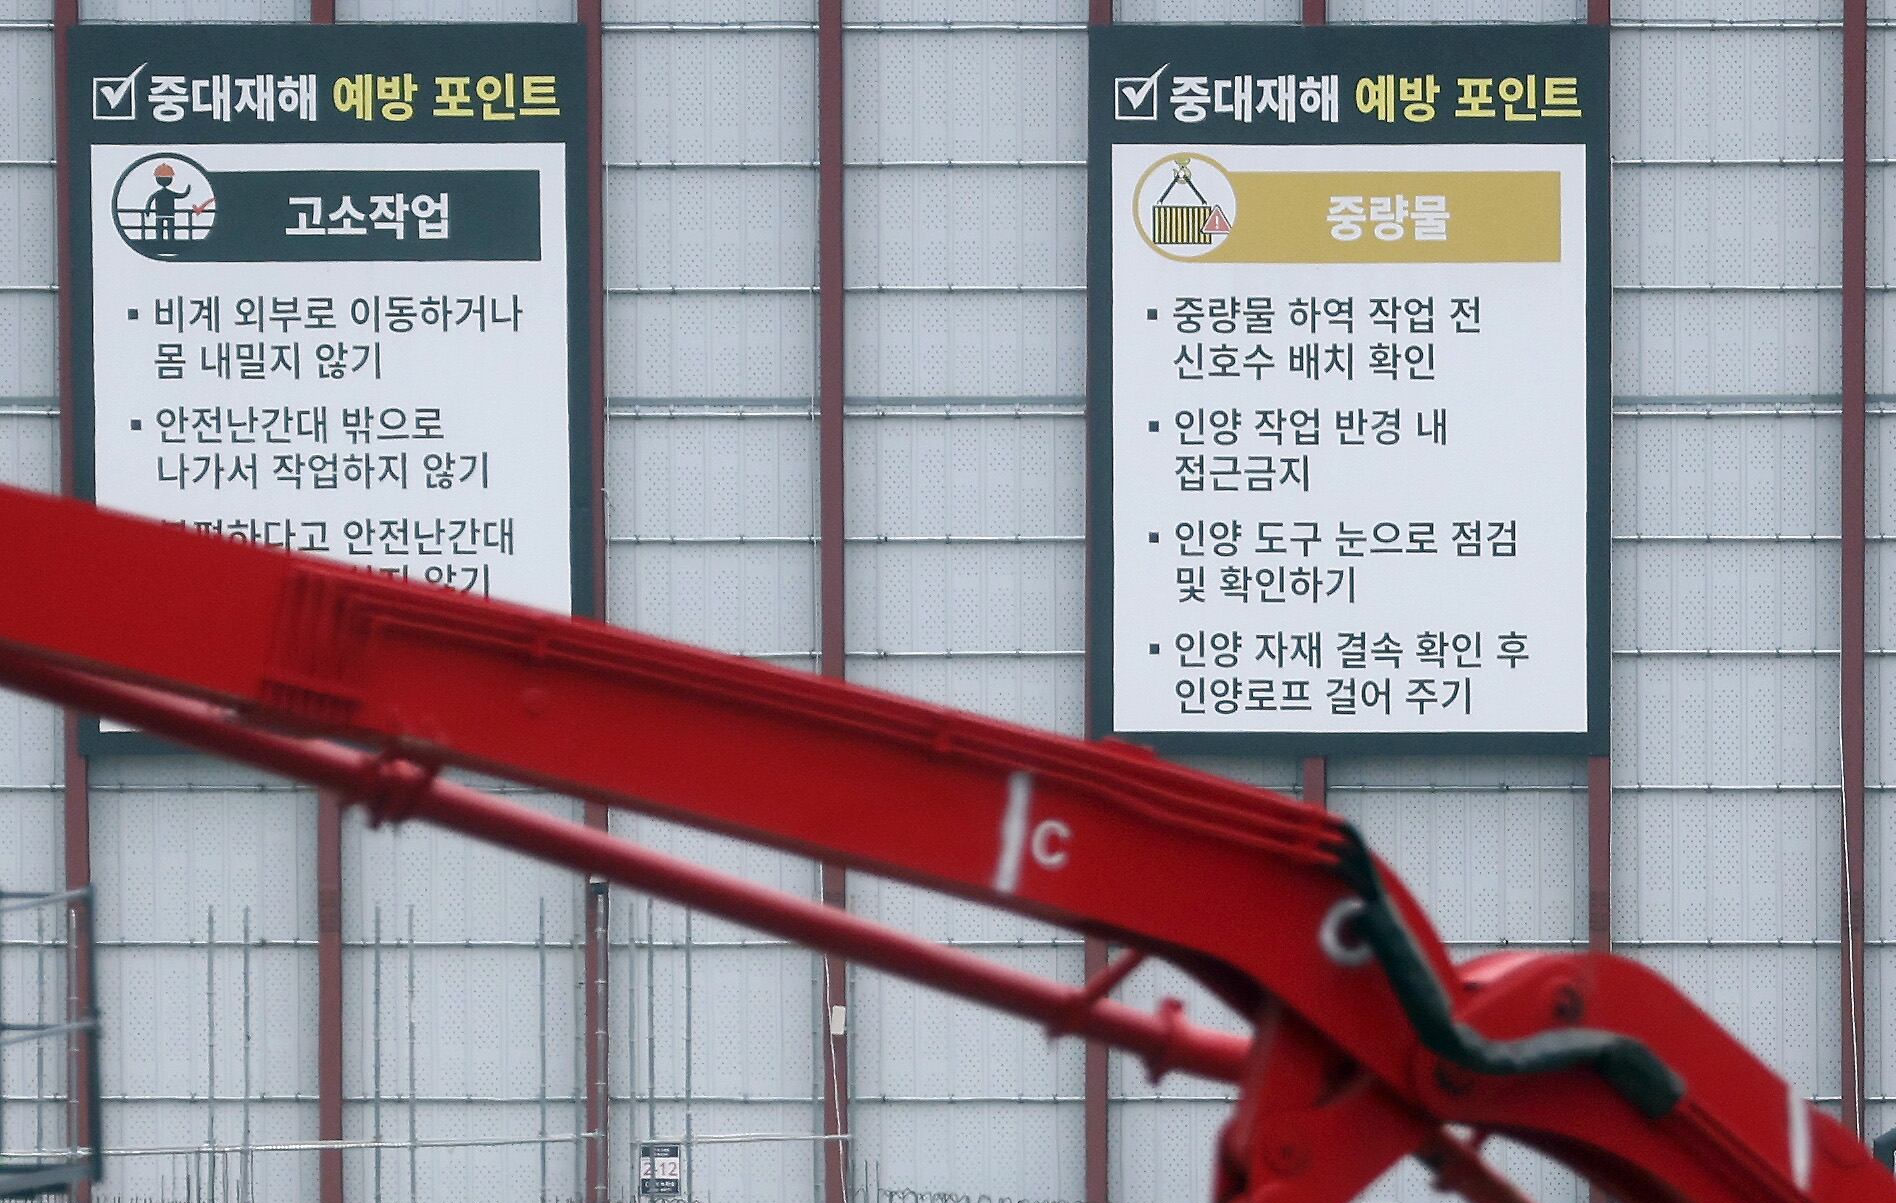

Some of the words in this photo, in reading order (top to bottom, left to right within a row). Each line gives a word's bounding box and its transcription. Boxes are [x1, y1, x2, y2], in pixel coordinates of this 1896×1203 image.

[148, 74, 316, 122] 중대재해
[334, 73, 418, 121] 예방
[433, 73, 560, 120] 포인트
[1170, 75, 1338, 123] 중대재해
[1356, 74, 1440, 122] 예방
[1455, 75, 1581, 121] 포인트
[286, 193, 448, 239] 고소작업
[1327, 194, 1450, 241] 중량물
[156, 296, 219, 333] 비계
[235, 296, 336, 333] 외부로
[351, 295, 523, 332] 이동하거나
[1173, 297, 1275, 334] 중량물
[1289, 297, 1353, 333] 하역
[1370, 297, 1433, 333] 작업
[1451, 297, 1480, 333] 전
[155, 344, 185, 379] 몸
[202, 342, 299, 379] 내밀지
[316, 342, 380, 379] 않기
[1174, 343, 1274, 380] 신호수
[1290, 343, 1352, 380] 배치
[1369, 343, 1434, 380] 확인
[157, 407, 327, 443] 안전난간대
[343, 407, 444, 444] 밖으로
[1176, 408, 1241, 445] 인양
[1256, 408, 1319, 445] 작업
[1336, 408, 1399, 445] 반경
[1418, 409, 1446, 445] 내
[158, 453, 256, 489] 나가서
[274, 453, 406, 489] 작업하지
[424, 452, 487, 489] 않기
[1175, 455, 1308, 491] 접근금지
[161, 519, 330, 553] 하다고
[344, 518, 513, 555] 안전난간대
[1176, 520, 1241, 556] 인양
[1255, 523, 1321, 557] 도구
[1336, 522, 1437, 556] 눈으로
[1452, 520, 1515, 556] 점검
[1177, 567, 1205, 602] 및
[1220, 566, 1354, 603] 확인하기
[1176, 631, 1241, 667] 인양
[1256, 631, 1321, 668] 자재
[1337, 632, 1403, 668] 결속
[1416, 631, 1481, 668] 확인
[1497, 631, 1528, 668] 후
[1176, 678, 1311, 714] 인양로프
[1327, 678, 1390, 715] 걸어
[1406, 678, 1470, 714] 주기
